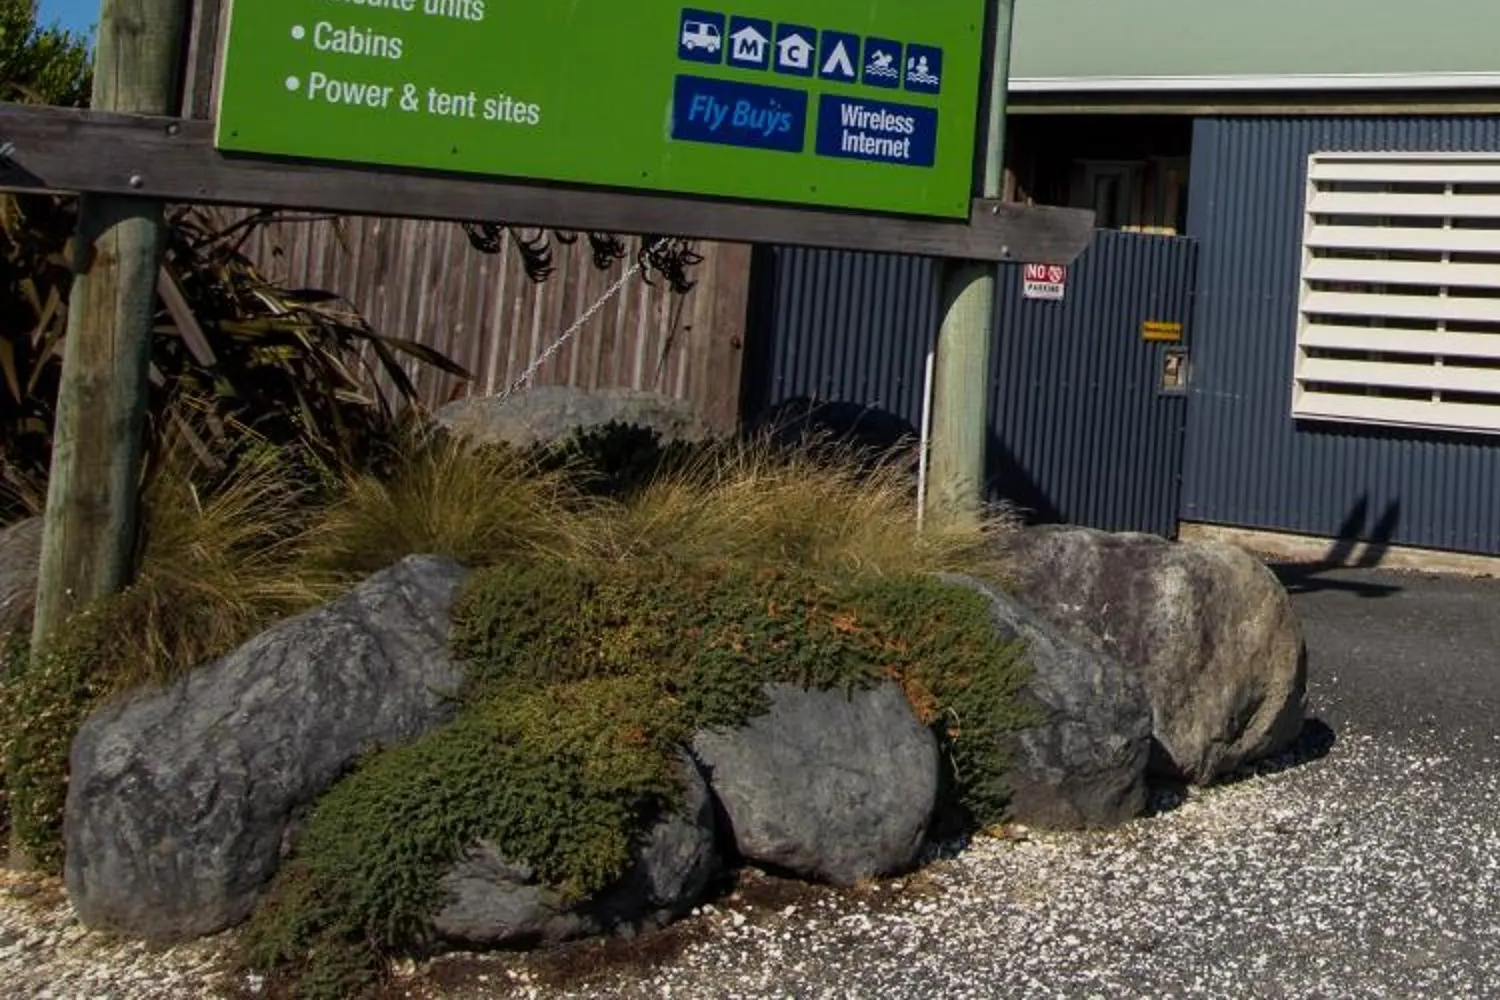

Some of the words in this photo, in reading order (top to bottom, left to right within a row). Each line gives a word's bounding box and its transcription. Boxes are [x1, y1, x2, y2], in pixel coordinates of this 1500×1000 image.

[313, 21, 403, 60] Cabins
[308, 71, 393, 109] Power
[399, 83, 418, 112] &
[427, 87, 478, 118] tent
[483, 94, 540, 126] sites
[688, 95, 729, 132] Fly
[733, 99, 792, 136] Buys
[841, 103, 915, 135] Wireless
[841, 131, 911, 159] Internet
[1027, 263, 1046, 280] NO
